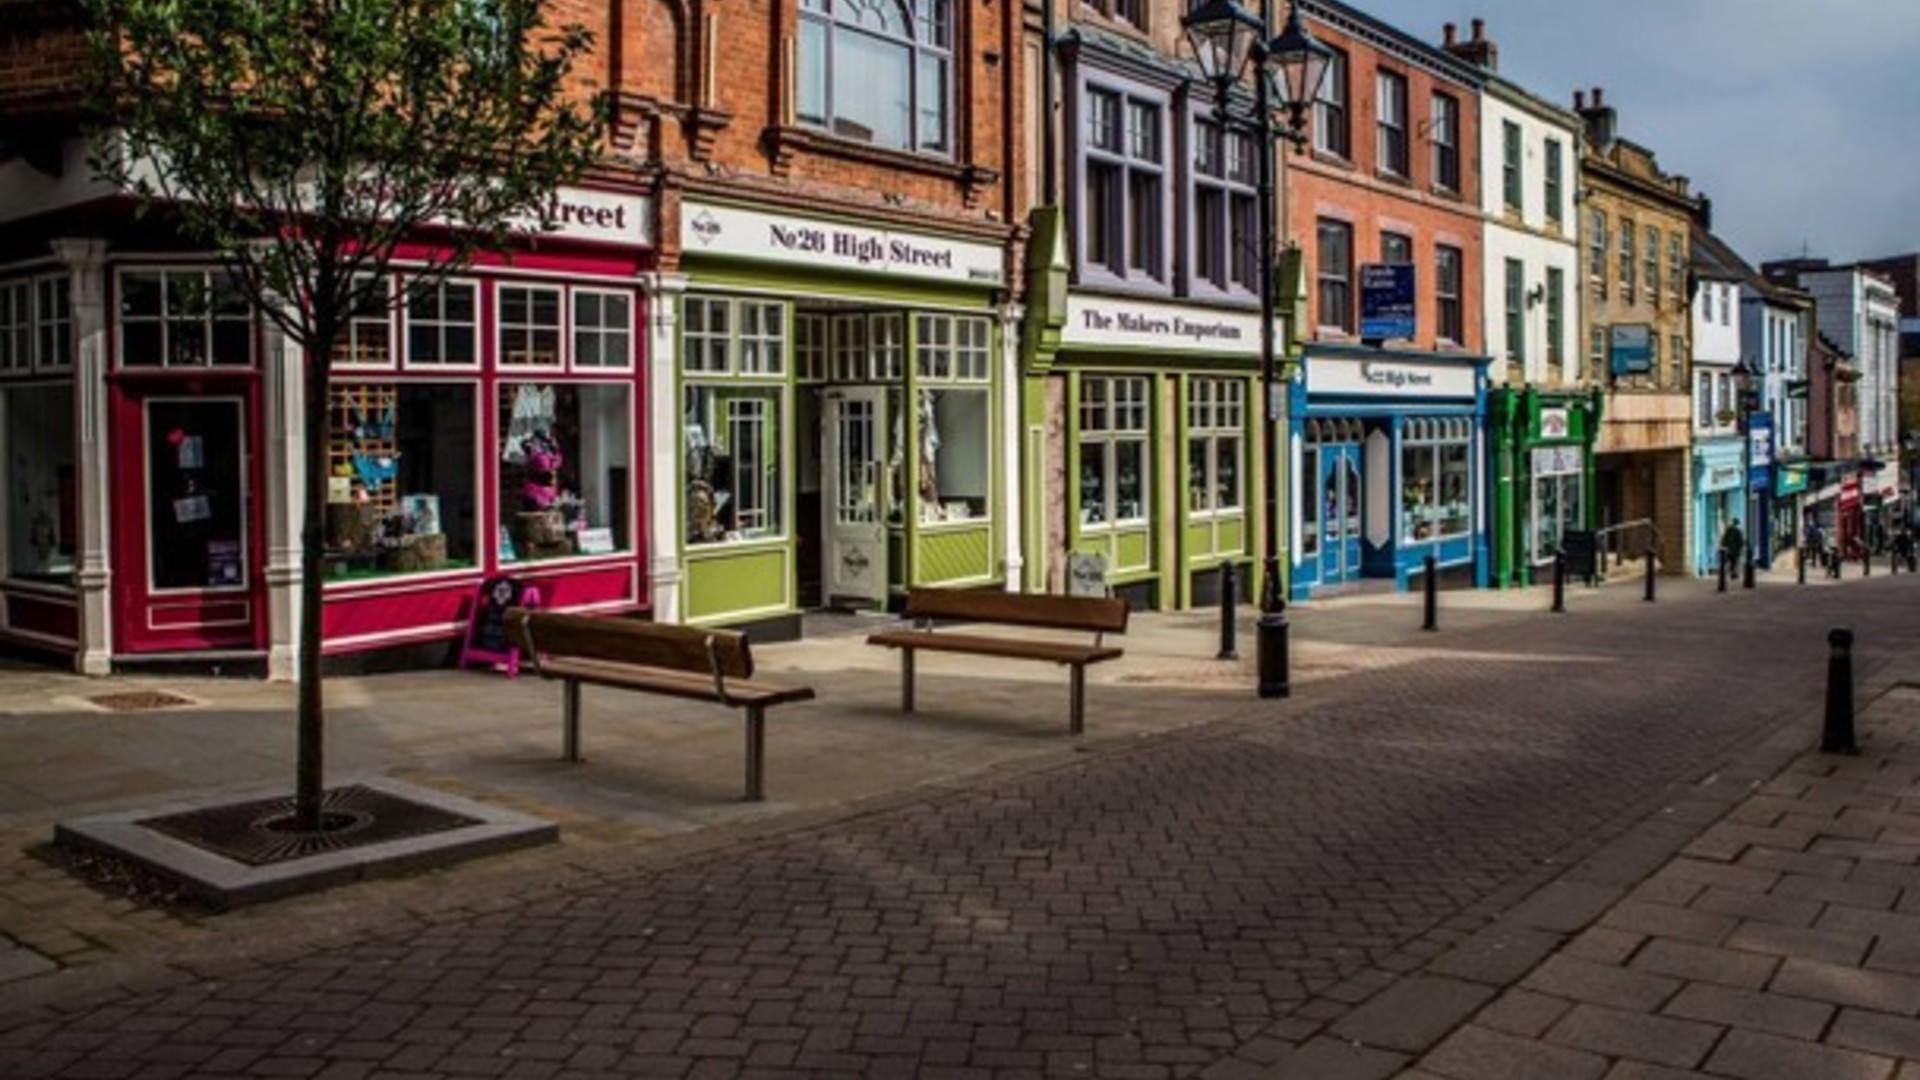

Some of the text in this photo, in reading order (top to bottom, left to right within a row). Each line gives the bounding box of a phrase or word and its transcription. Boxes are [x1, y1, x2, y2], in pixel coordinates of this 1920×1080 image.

[769, 223, 953, 269] No26 High Street
[1082, 309, 1242, 342] The Makers Emporium
